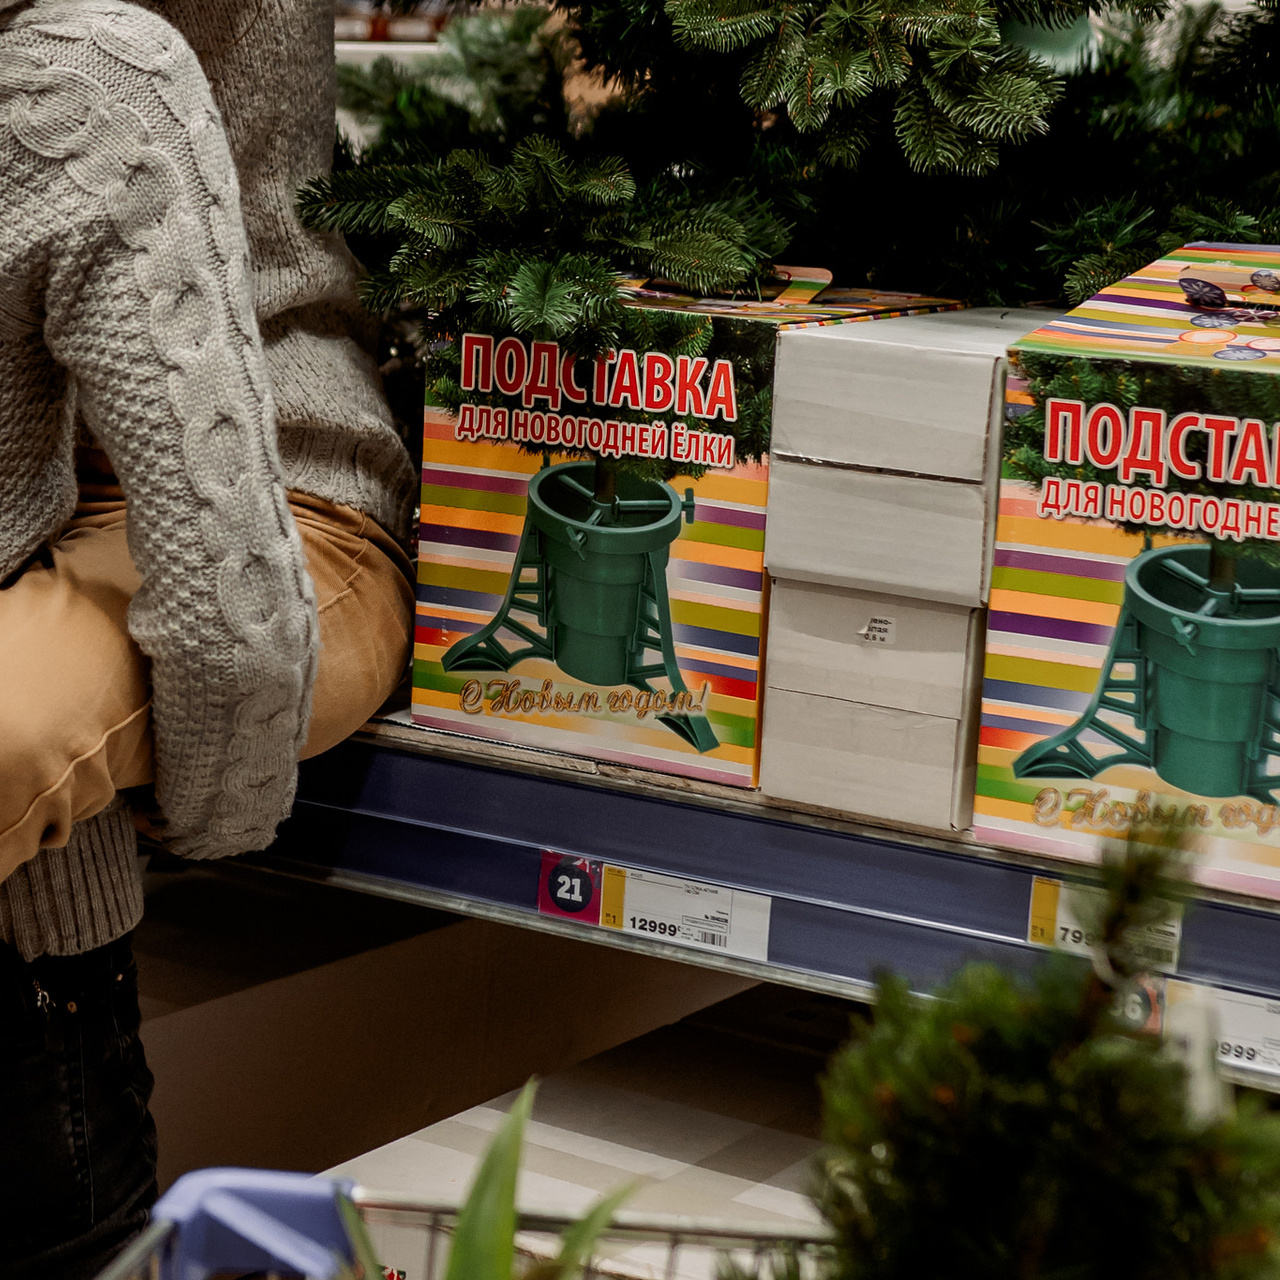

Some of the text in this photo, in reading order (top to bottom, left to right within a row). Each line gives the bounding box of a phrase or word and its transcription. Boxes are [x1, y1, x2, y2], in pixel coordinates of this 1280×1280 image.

[461, 334, 736, 420] ПОДСТАВКА
[456, 404, 735, 468] ДЛЯ НОВОГОДНЕЙ ЁЛКИ
[1045, 399, 1280, 486] ПОДСТА
[1038, 477, 1104, 519] ДЛЯ
[459, 678, 708, 718] С Новым годом!
[556, 875, 583, 902] 21
[629, 916, 677, 937] 12999
